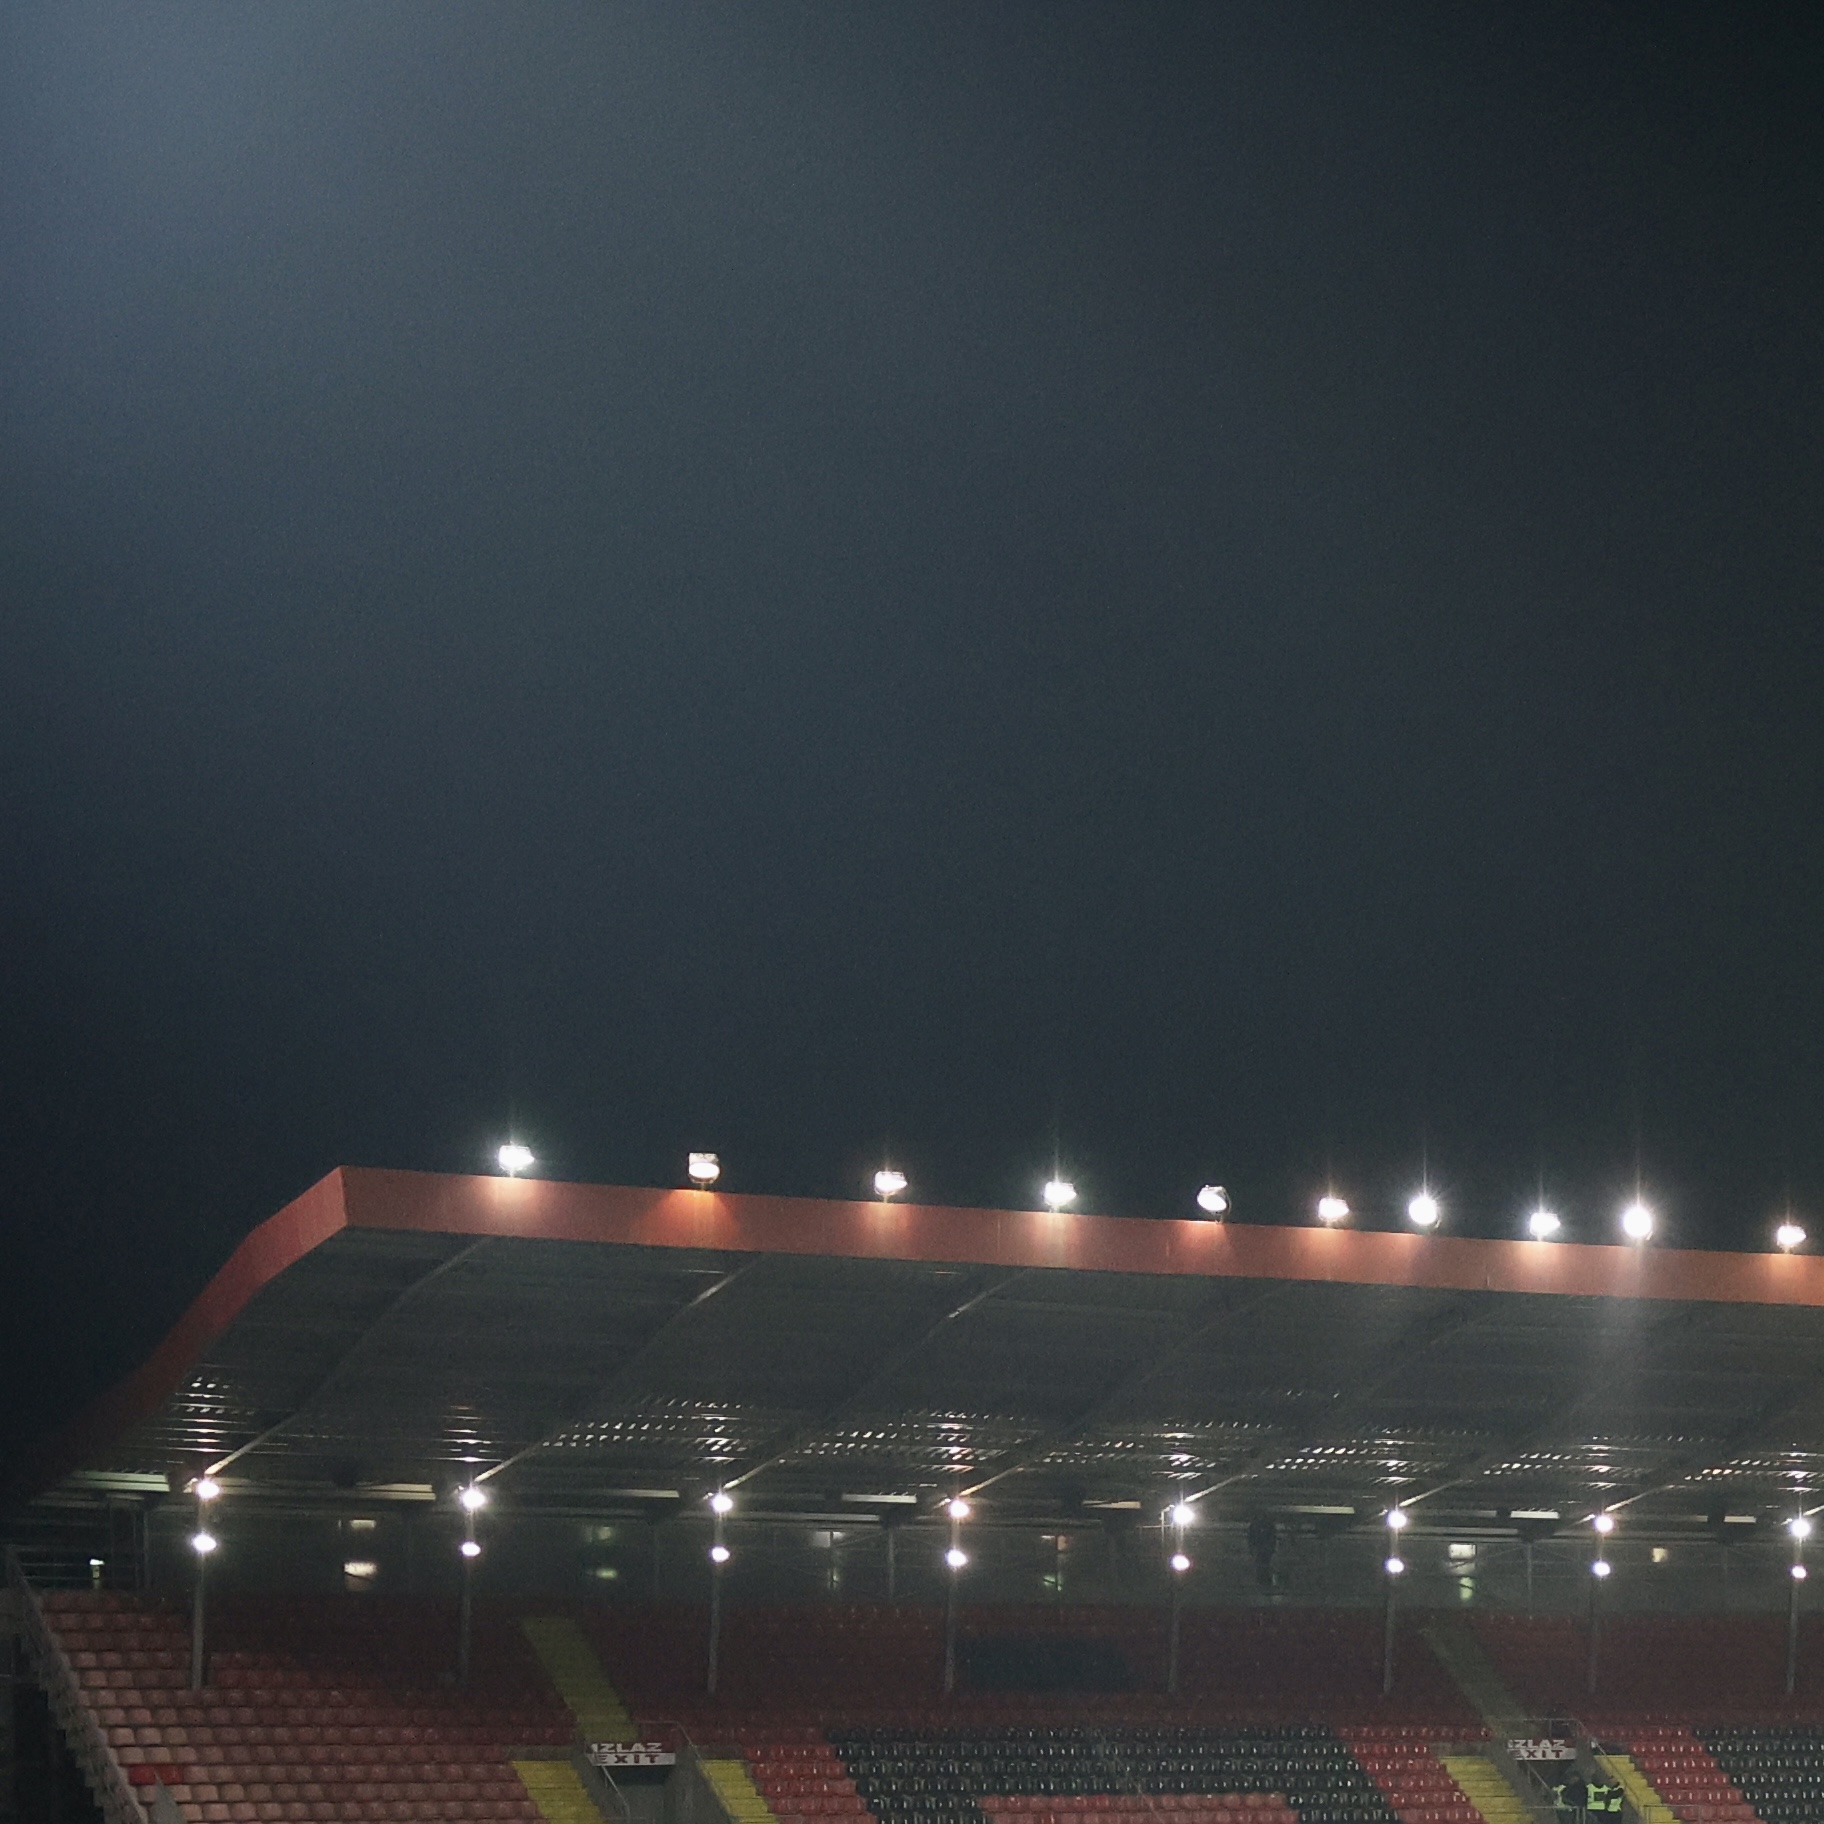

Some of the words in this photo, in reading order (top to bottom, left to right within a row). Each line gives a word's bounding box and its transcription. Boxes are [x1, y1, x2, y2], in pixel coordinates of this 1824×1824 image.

[591, 1742, 662, 1753] IZLAZ
[1507, 1739, 1566, 1749] IZLAZ
[598, 1754, 659, 1764] EXIT
